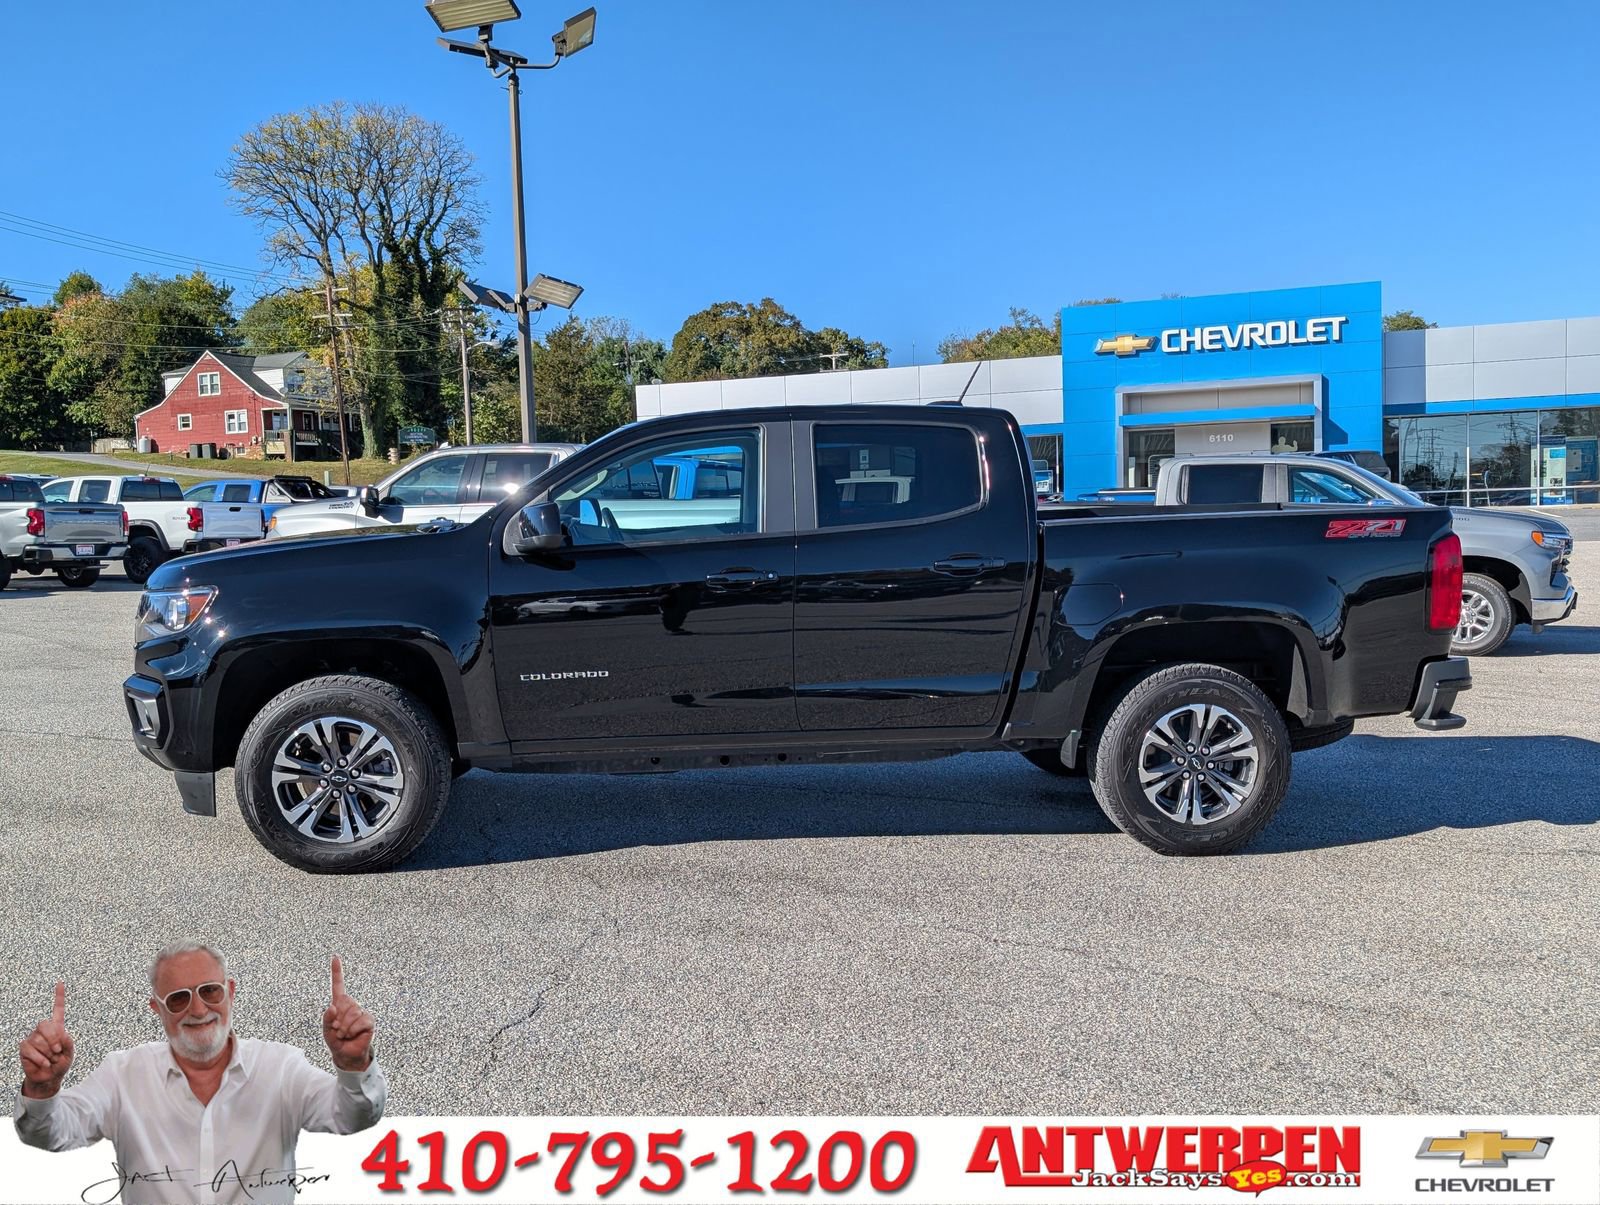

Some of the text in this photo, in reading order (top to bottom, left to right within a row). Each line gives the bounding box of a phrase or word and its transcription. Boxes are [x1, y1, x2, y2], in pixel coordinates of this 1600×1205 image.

[1161, 316, 1346, 353] CHEVROLET
[1208, 433, 1234, 443] 6110
[1325, 519, 1406, 538] Z71
[519, 670, 609, 681] COLORADO
